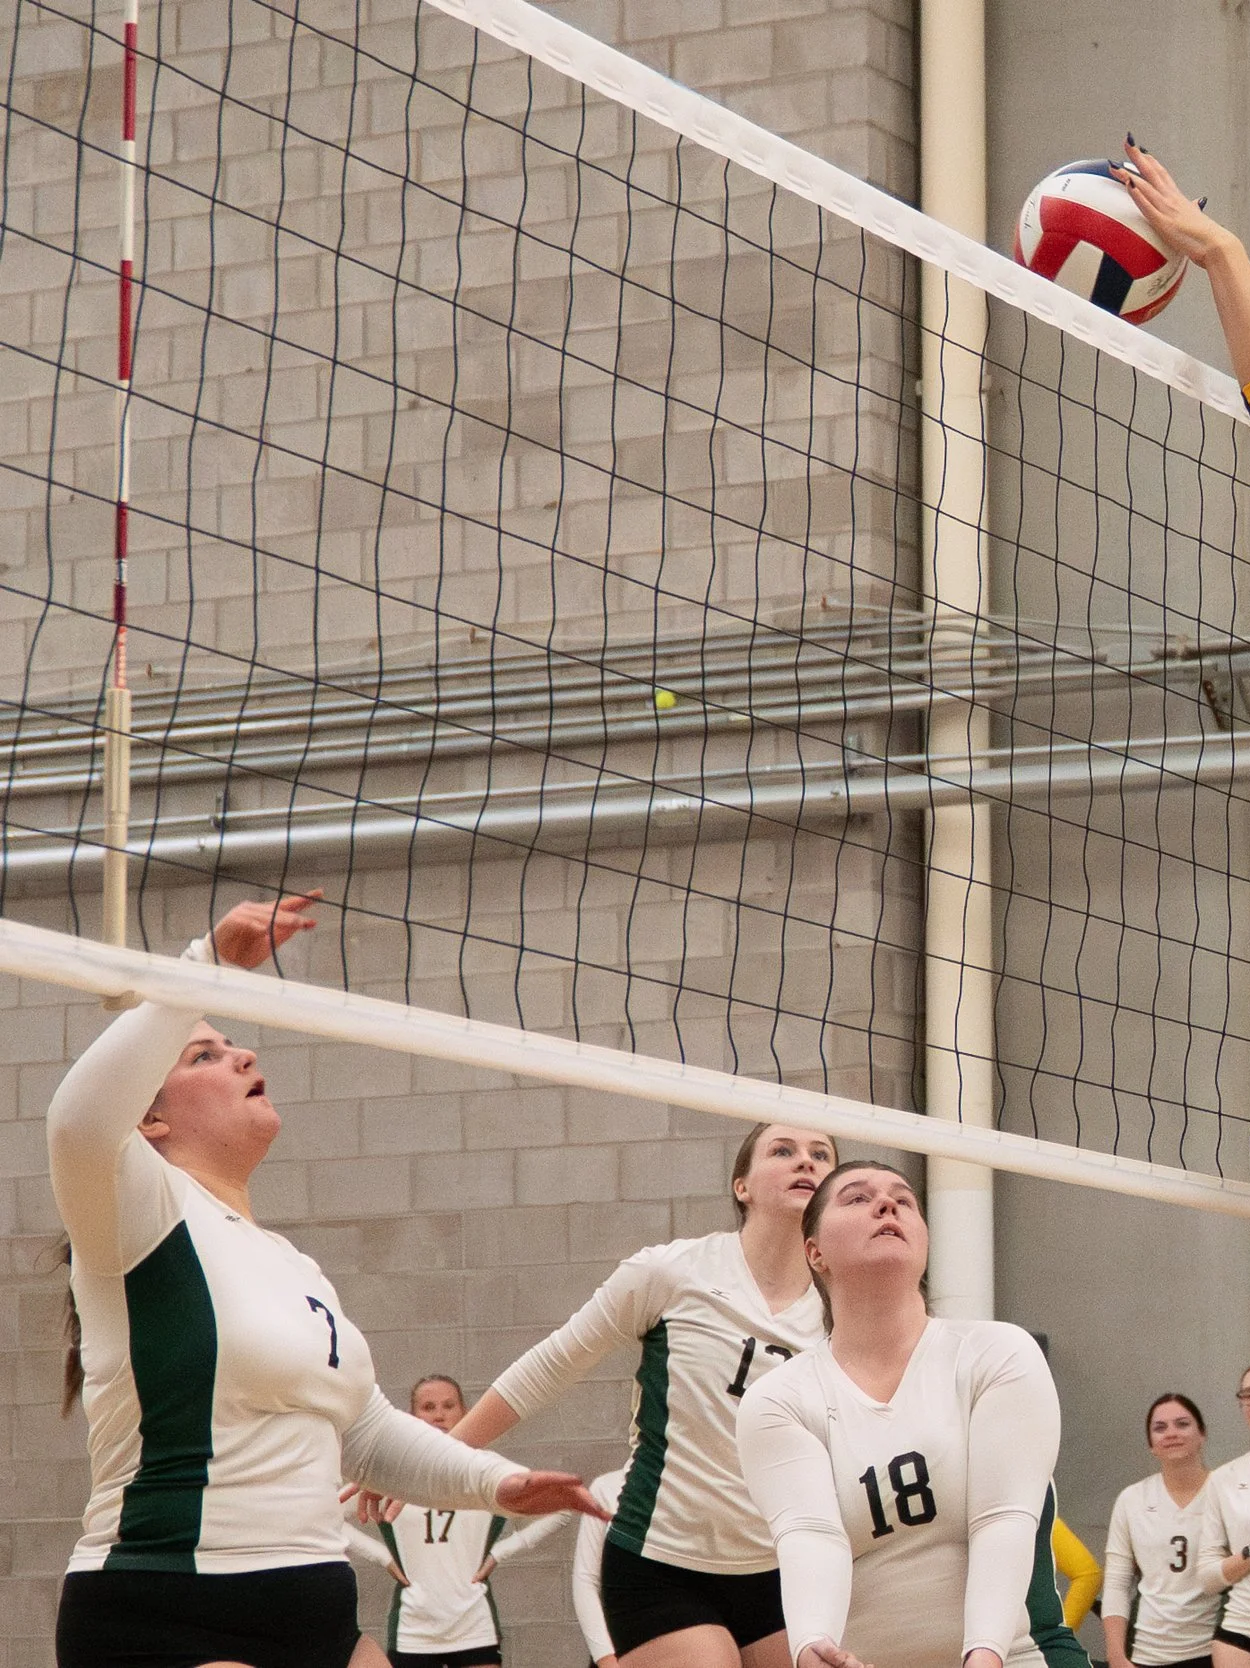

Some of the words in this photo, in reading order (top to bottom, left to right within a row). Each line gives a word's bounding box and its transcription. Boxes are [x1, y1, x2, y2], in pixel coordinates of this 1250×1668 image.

[305, 1295, 339, 1369] 7
[859, 1451, 937, 1539] 18
[424, 1509, 455, 1544] 17
[1170, 1535, 1188, 1573] 3
